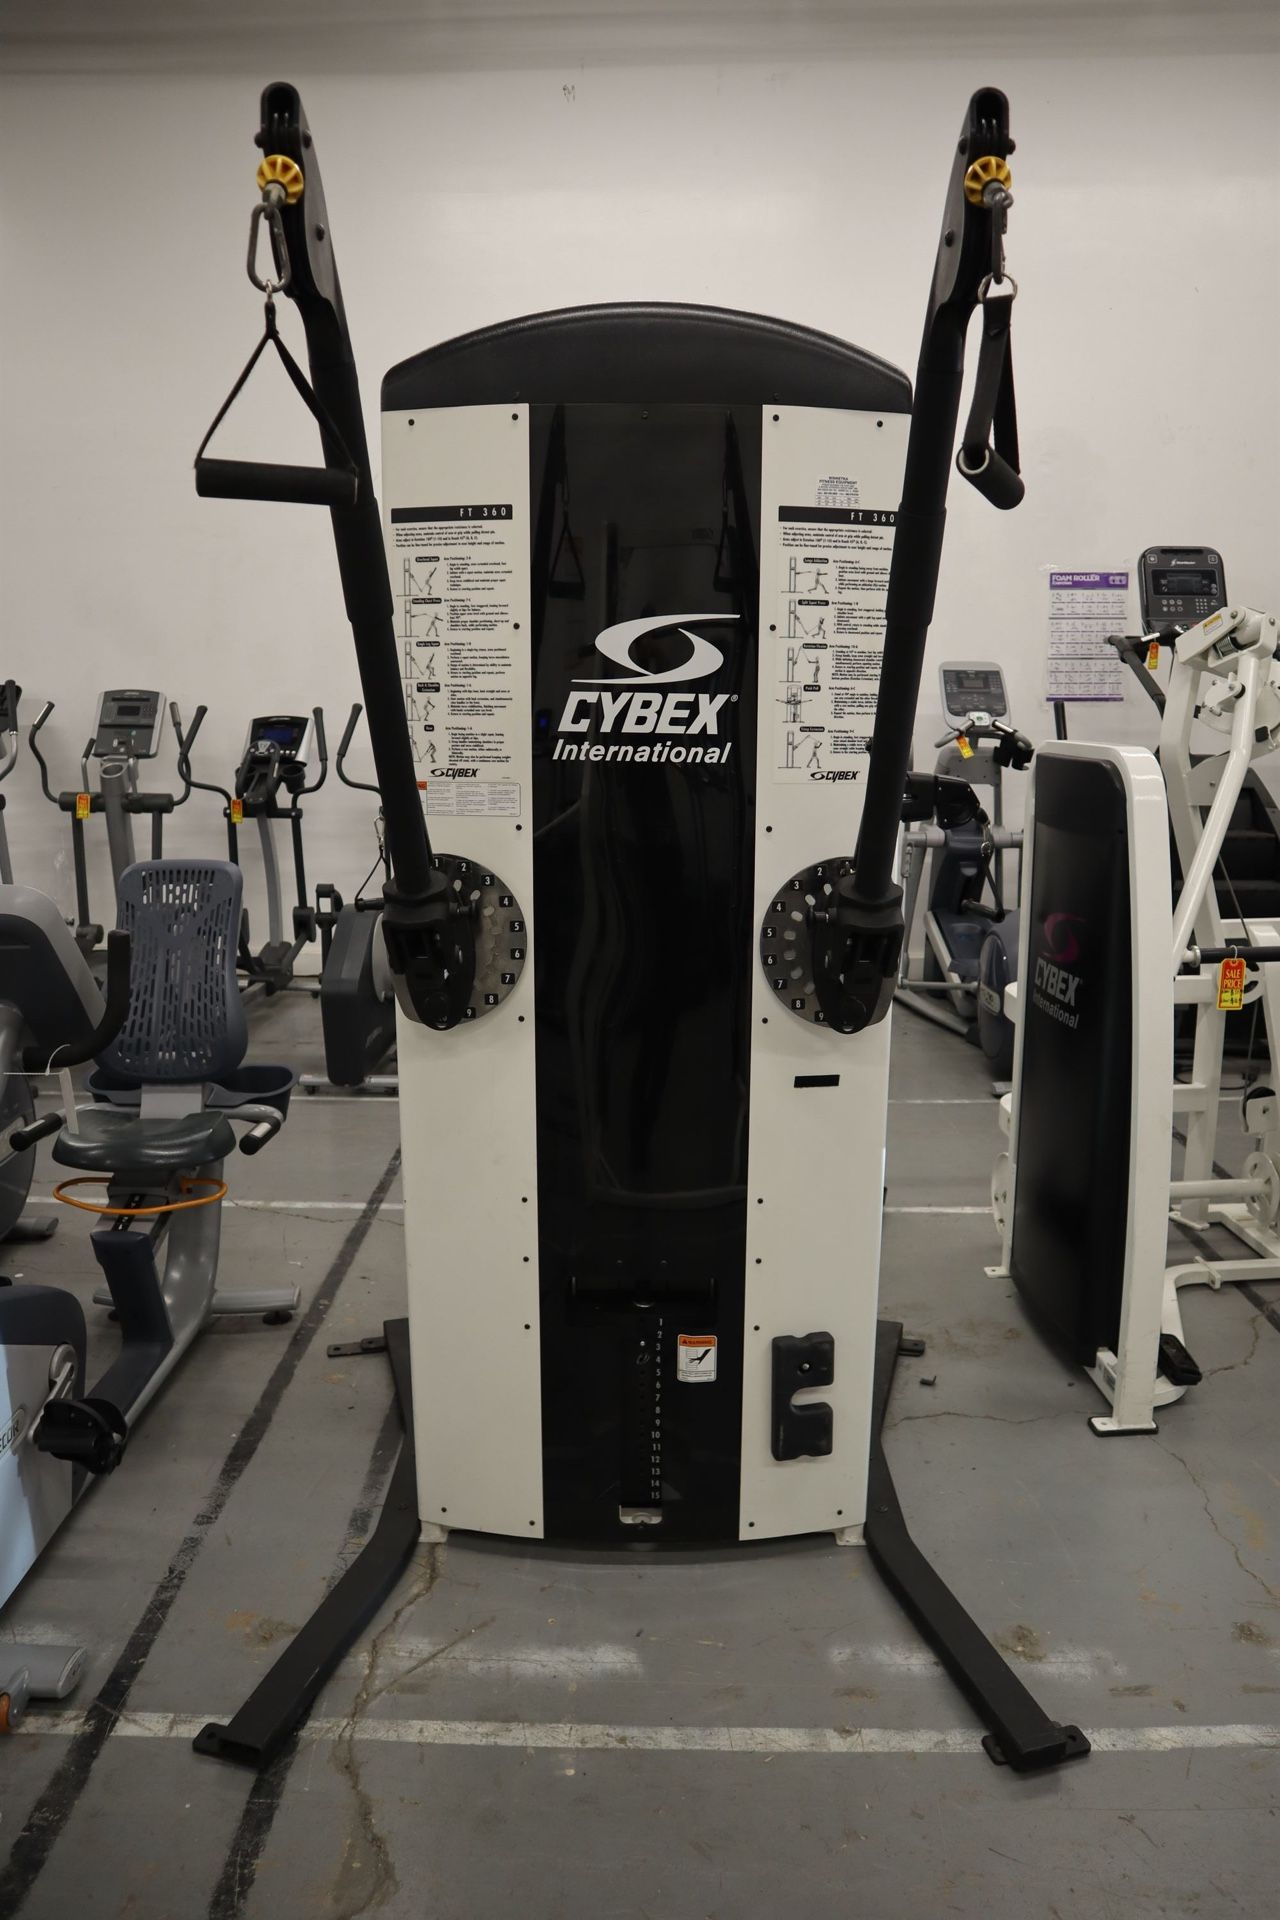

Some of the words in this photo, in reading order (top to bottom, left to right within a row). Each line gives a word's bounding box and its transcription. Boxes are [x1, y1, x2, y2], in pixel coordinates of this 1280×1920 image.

[460, 507, 472, 517] FT
[482, 506, 507, 517] 360
[850, 512, 863, 521] FT
[872, 513, 895, 523] 360
[552, 738, 732, 764] International
[444, 768, 479, 779] CYBEX
[825, 771, 859, 783] CYBEX
[1225, 969, 1241, 979] SALE
[1035, 957, 1080, 1006] CYBEX
[1223, 979, 1242, 989] PRICE
[651, 1431, 661, 1439] 10
